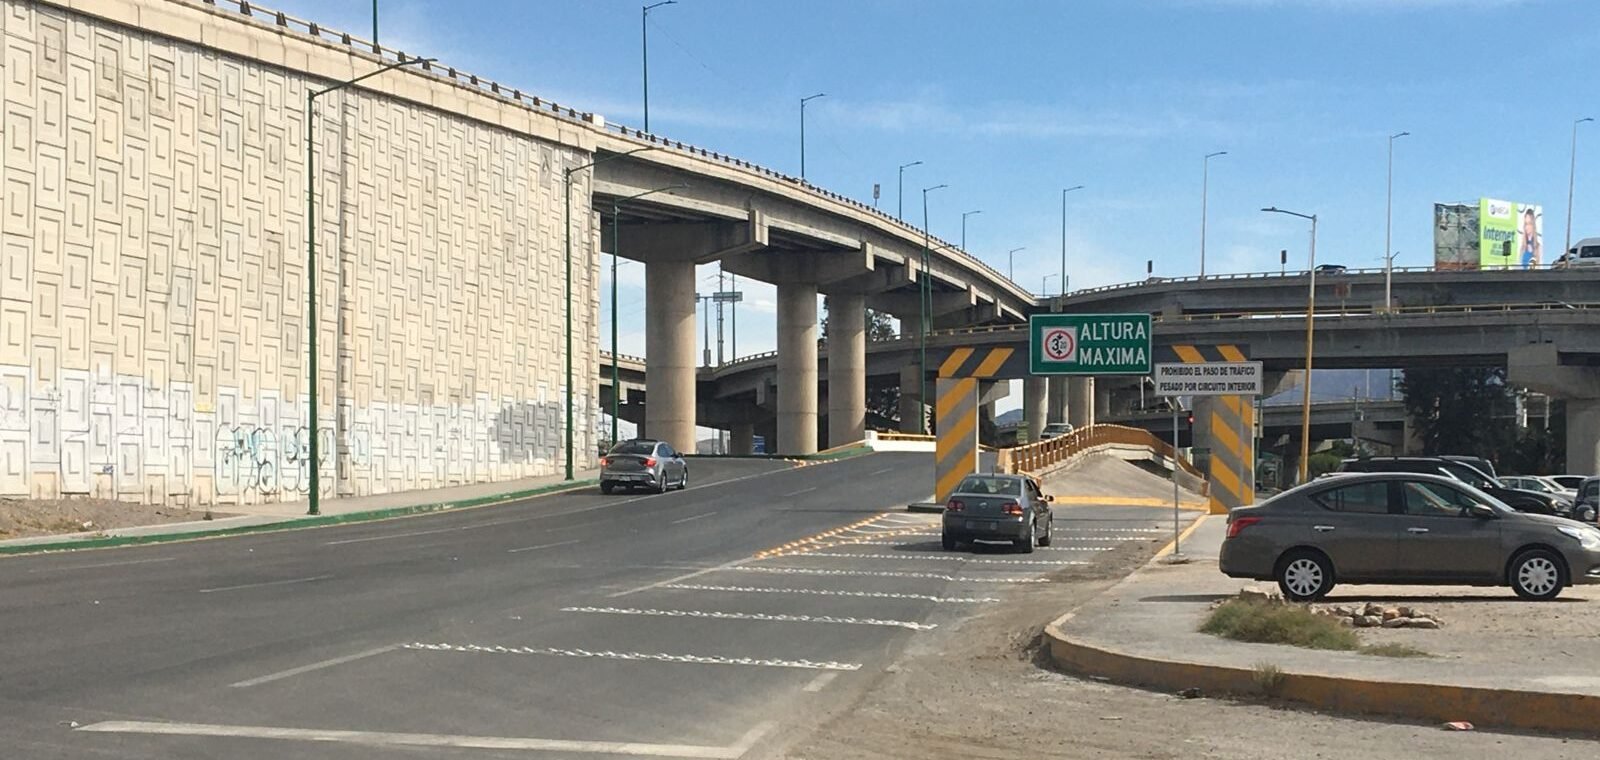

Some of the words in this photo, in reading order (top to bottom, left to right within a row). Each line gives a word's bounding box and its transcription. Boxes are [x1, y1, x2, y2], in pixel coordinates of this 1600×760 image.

[1484, 226, 1515, 242] Internet
[1080, 322, 1147, 341] ALTURA
[1080, 347, 1147, 366] MAXIMA
[1161, 367, 1193, 376] PROHIBIDO
[1194, 367, 1202, 376] EL
[1203, 367, 1219, 376] PASO
[1220, 367, 1228, 376] DE
[1160, 382, 1183, 391] PESADO
[1184, 382, 1197, 391] POR
[1198, 382, 1226, 391] CIRCUITO
[1227, 382, 1256, 391] INTERIOR
